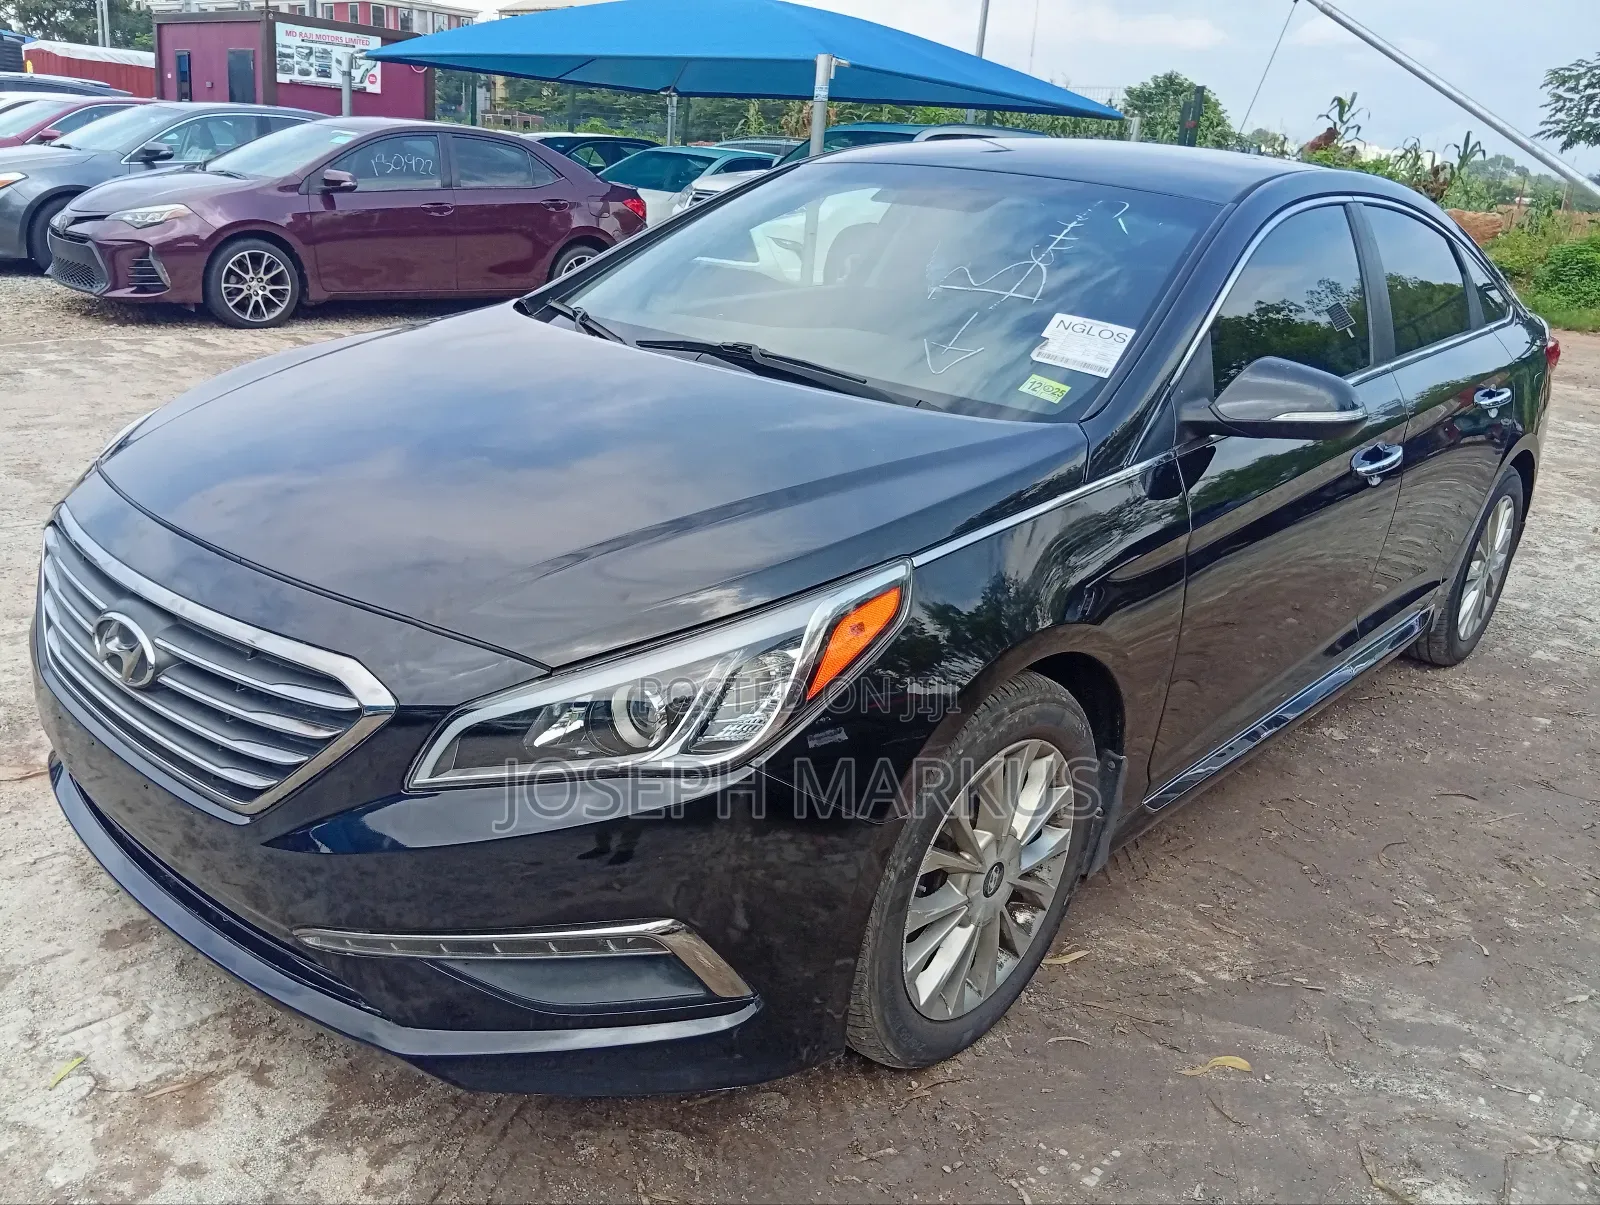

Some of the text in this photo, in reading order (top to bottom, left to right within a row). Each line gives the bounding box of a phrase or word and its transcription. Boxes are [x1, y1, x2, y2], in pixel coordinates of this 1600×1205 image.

[285, 30, 297, 38] MD
[298, 32, 314, 40] RAJI
[315, 33, 343, 43] MOTORS
[344, 37, 370, 46] LIMITED
[1056, 320, 1128, 343] NGLOS
[1028, 380, 1067, 398] 12 25
